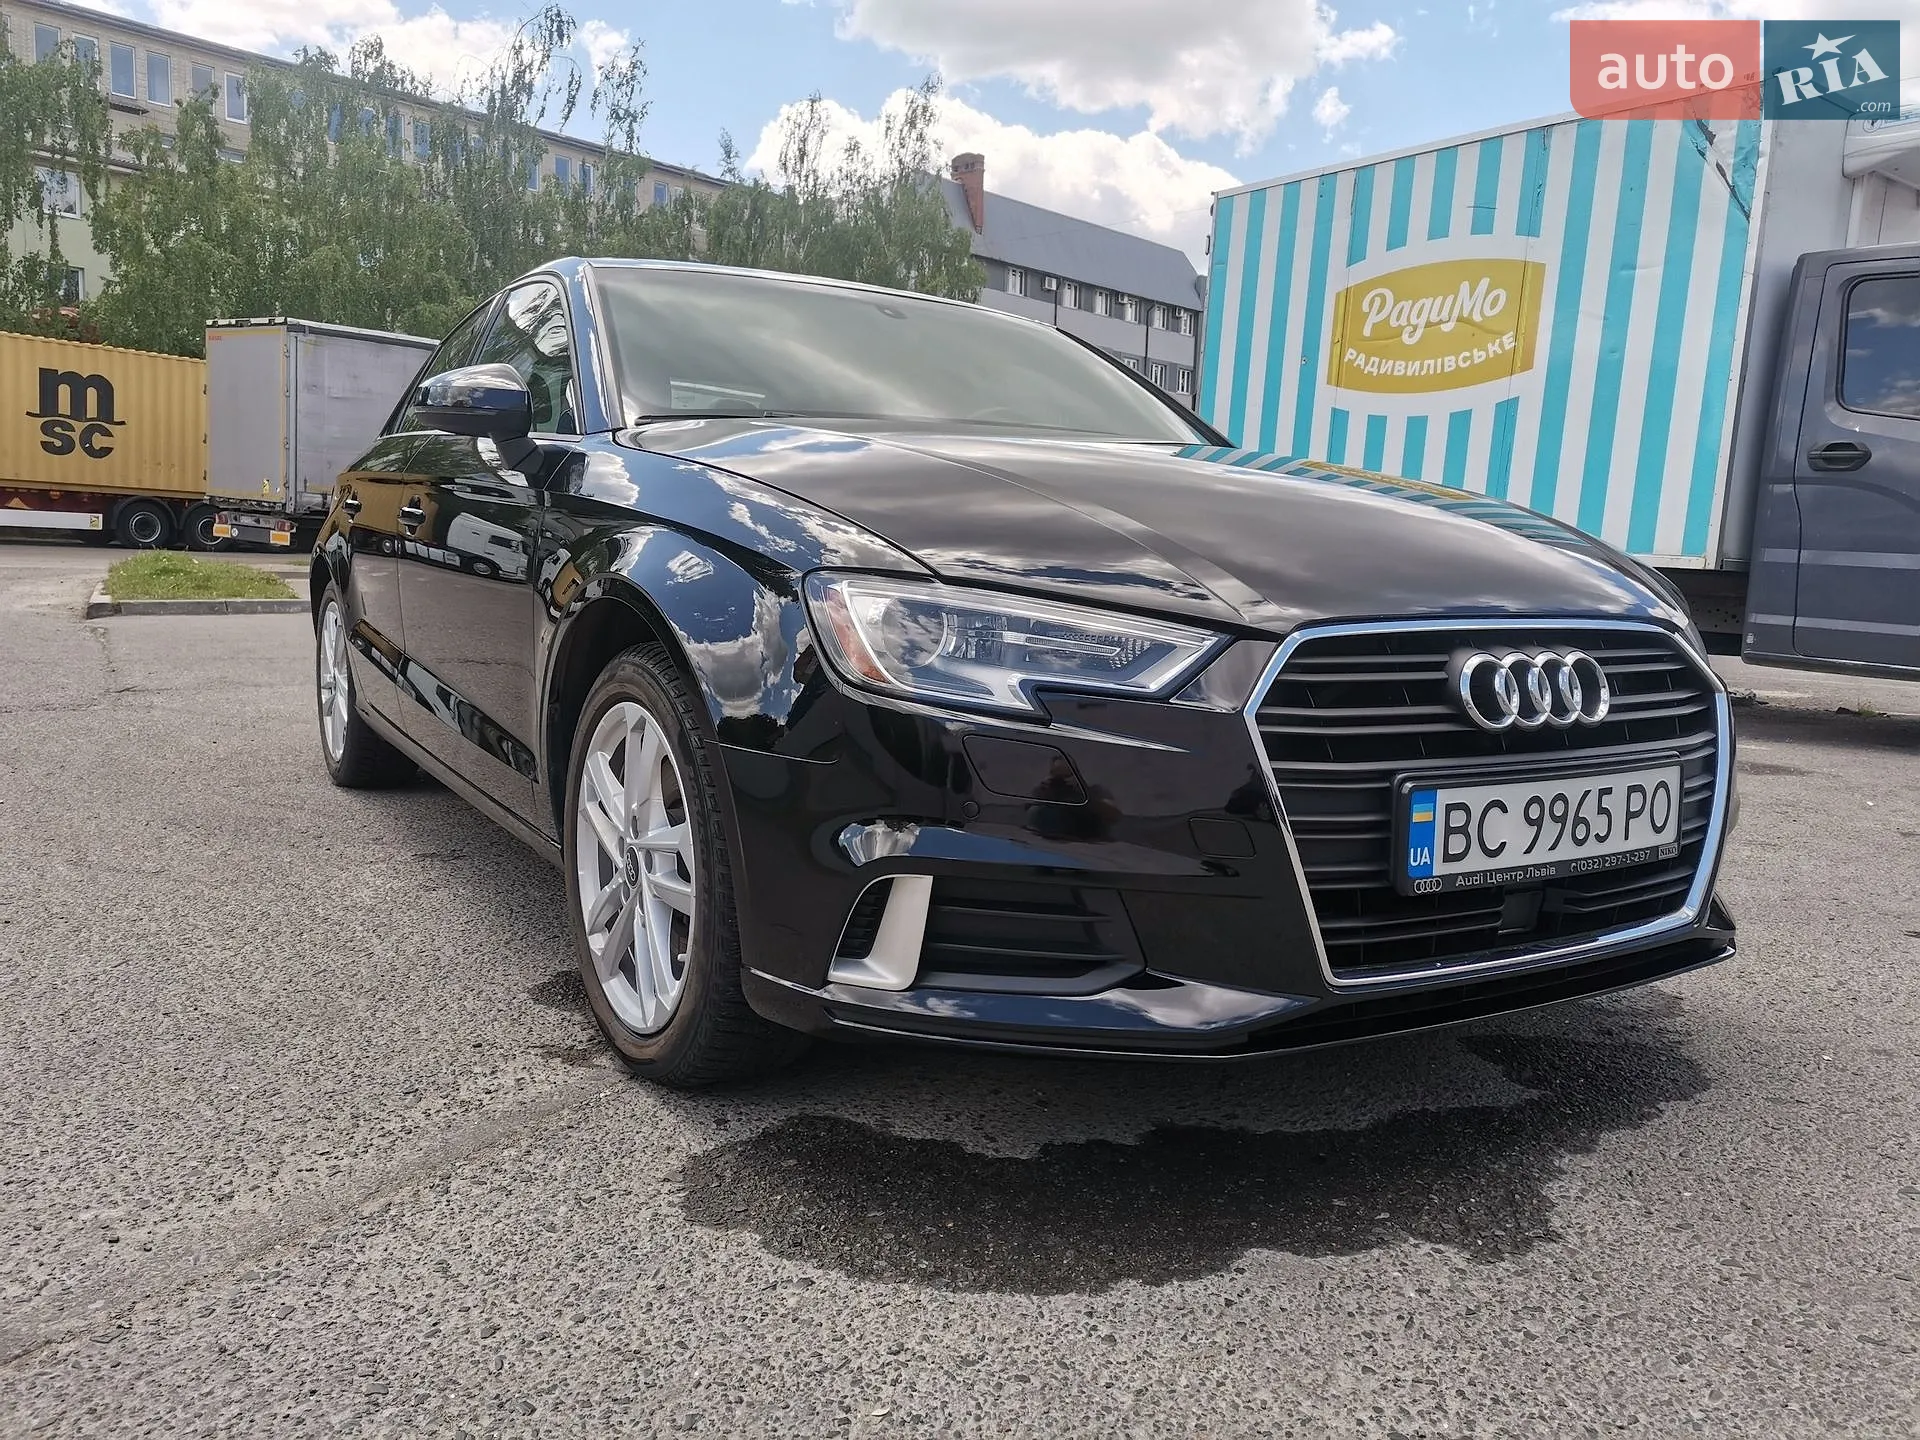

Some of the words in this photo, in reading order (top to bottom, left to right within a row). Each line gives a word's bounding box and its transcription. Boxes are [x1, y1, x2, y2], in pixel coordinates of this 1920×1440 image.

[1344, 331, 1516, 376] РАДИВИЛІВСЬКЕ
[1442, 799, 1509, 863] BC
[1523, 786, 1613, 854] 9965
[1624, 780, 1671, 841] PO
[1410, 847, 1431, 866] UA
[1456, 874, 1484, 887] Audi
[1487, 870, 1524, 885] Центр
[1526, 865, 1556, 878] Львів
[1605, 850, 1651, 867] 297-1-297
